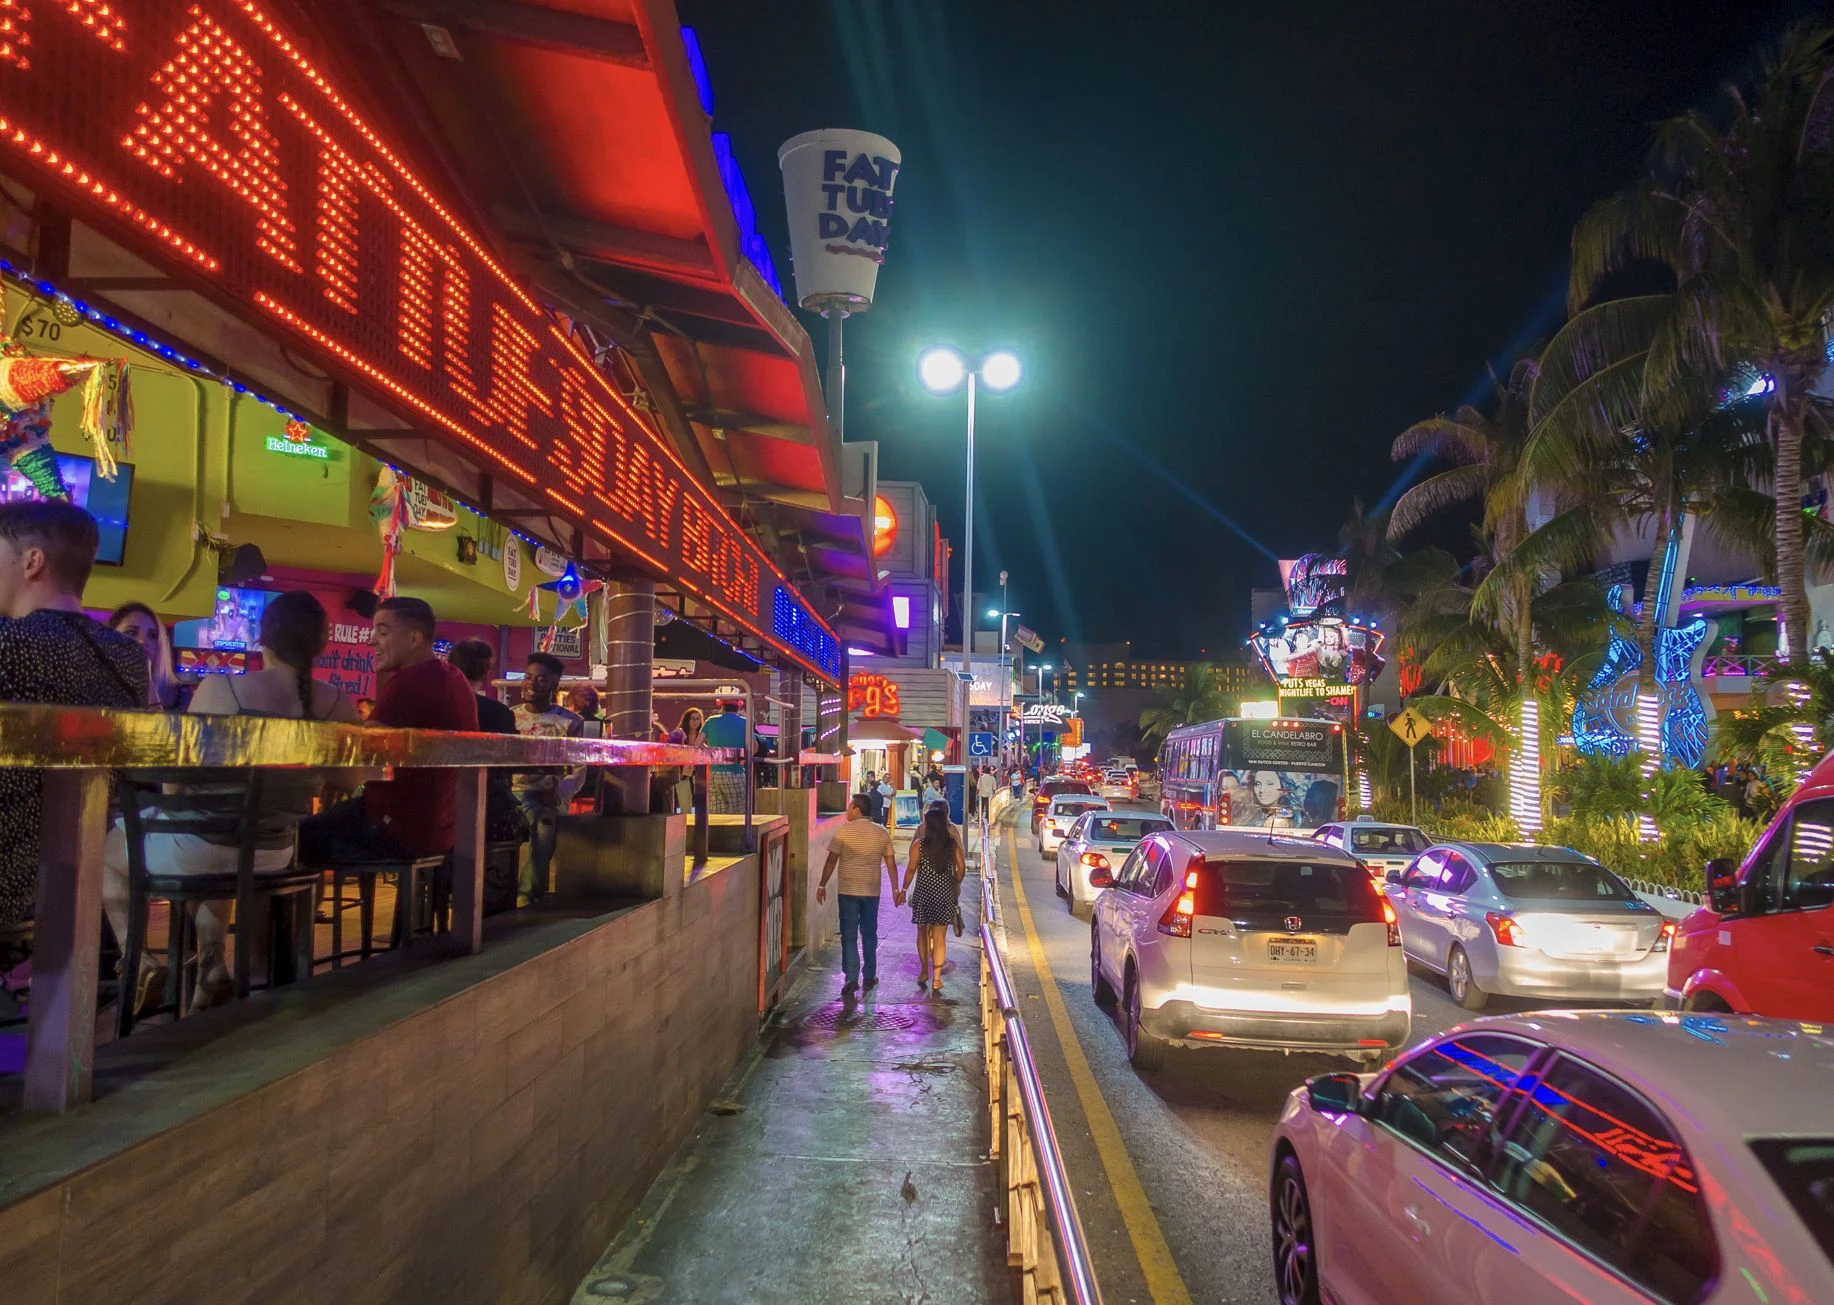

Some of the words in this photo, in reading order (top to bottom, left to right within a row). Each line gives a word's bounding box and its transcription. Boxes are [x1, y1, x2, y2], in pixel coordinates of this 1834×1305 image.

[823, 150, 900, 192] FAT
[22, 314, 61, 341] $70
[268, 437, 328, 458] Heineken
[334, 623, 359, 644] RULE
[1280, 688, 1314, 698] NIGHTLIFE
[1315, 688, 1326, 697] TO
[1304, 679, 1326, 688] VEGAS
[1251, 729, 1261, 738] EL
[1262, 730, 1324, 741] CANDELABRO
